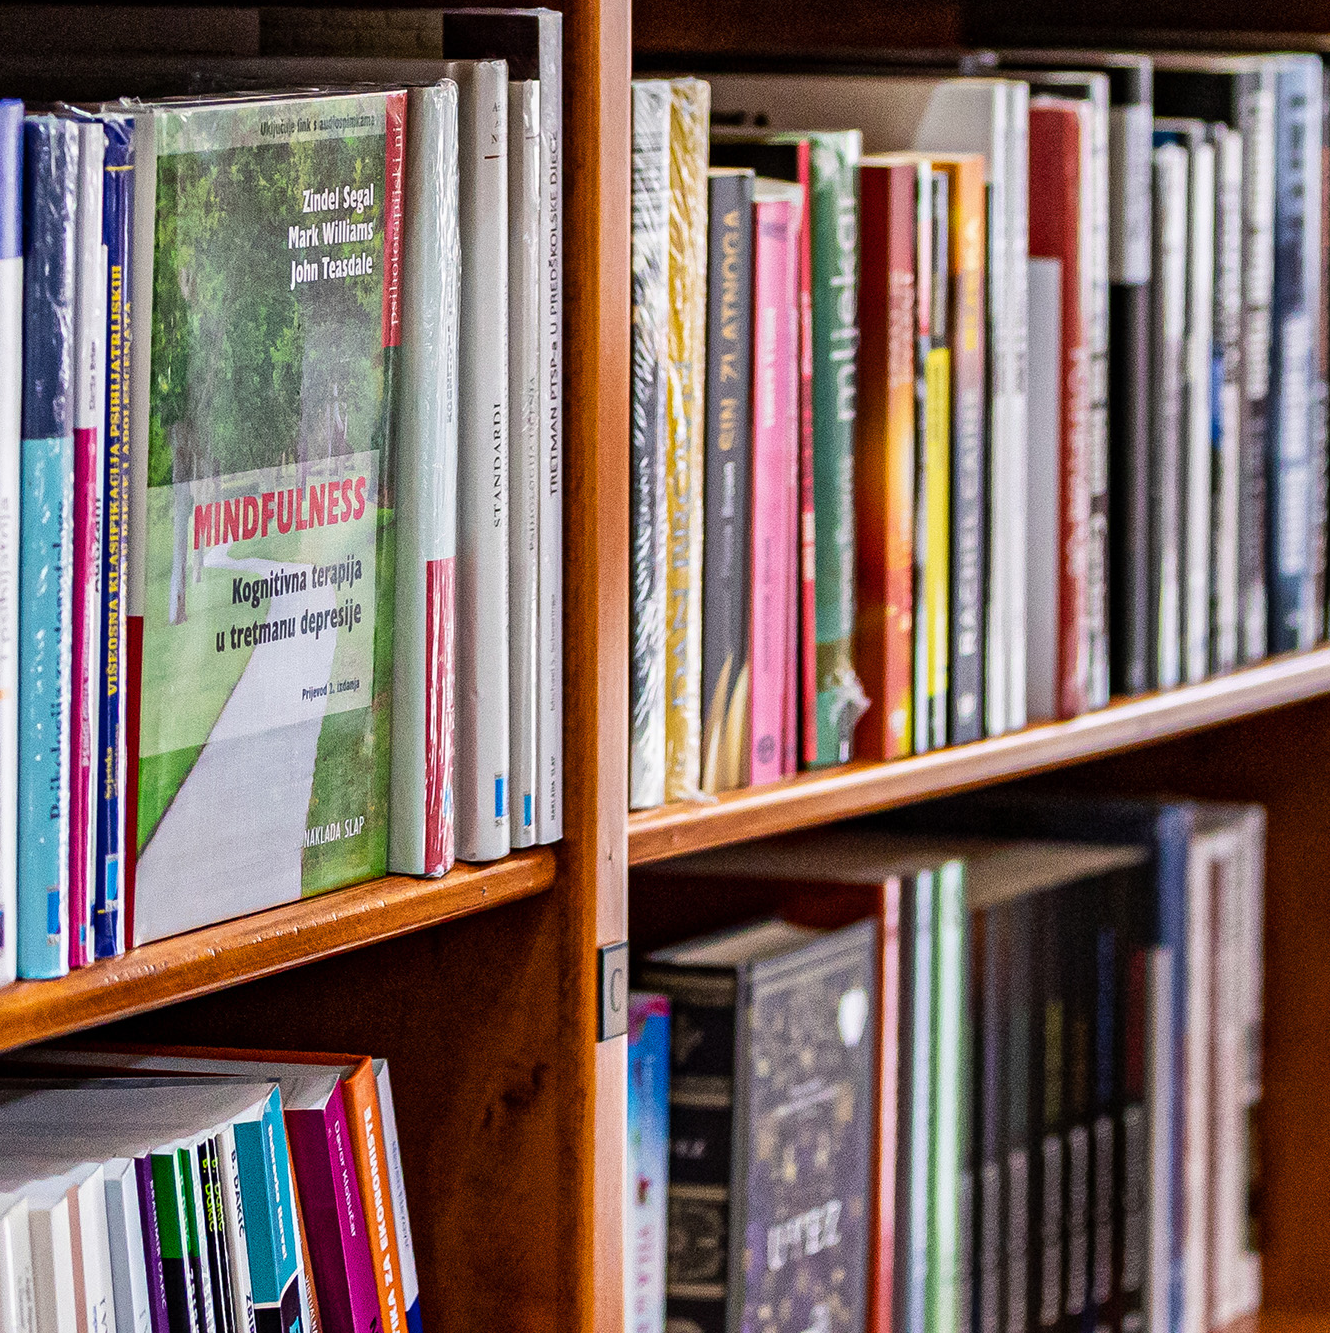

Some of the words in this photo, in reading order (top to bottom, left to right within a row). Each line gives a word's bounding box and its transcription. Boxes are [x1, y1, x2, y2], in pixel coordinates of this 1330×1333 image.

[393, 112, 405, 148] niz
[303, 186, 340, 214] Zindel
[344, 183, 374, 214] Segal
[289, 223, 319, 250] Mark
[322, 219, 373, 245] Williams
[390, 157, 404, 326] psihoterapijski
[548, 191, 558, 316] PREDŠKOLSKE
[290, 259, 318, 291] John
[322, 252, 373, 280] Teasdale
[110, 265, 122, 437] PSIHIJATRIJSKIH
[550, 322, 558, 335] U
[550, 341, 558, 401] PTSP-a
[493, 403, 502, 528] STANDARDI
[550, 408, 559, 496] TRETMAN
[108, 443, 121, 593] KLASIFIKACIJA
[193, 475, 366, 551] MINDFULNESS
[232, 568, 307, 608] Kognitivna
[312, 554, 363, 591] terapija
[105, 598, 119, 696] VIŠEOSNA
[216, 630, 225, 653] u
[230, 616, 296, 650] tretmanu
[300, 598, 362, 641] depresije
[302, 682, 327, 703] Prijevod
[337, 677, 360, 694] izdanja
[304, 821, 341, 848] NAKLADA
[343, 816, 365, 838] SLAP
[610, 967, 623, 1012] C
[334, 1120, 346, 1167] Davor
[363, 1104, 389, 1252] EKONOMISTE
[382, 1252, 394, 1287] ZA
